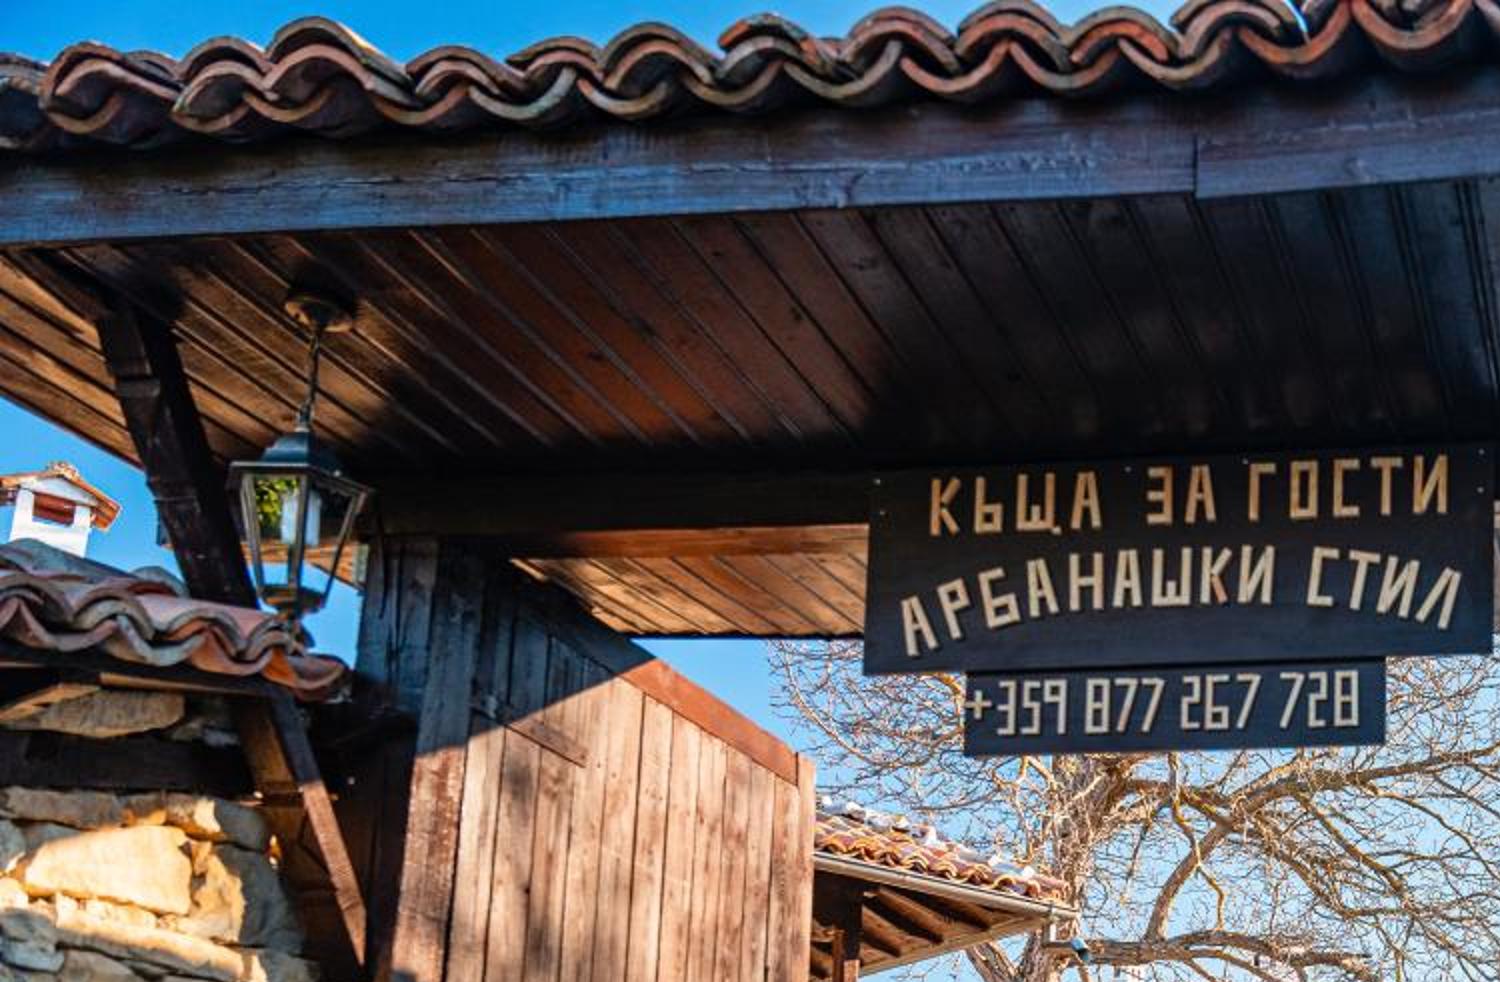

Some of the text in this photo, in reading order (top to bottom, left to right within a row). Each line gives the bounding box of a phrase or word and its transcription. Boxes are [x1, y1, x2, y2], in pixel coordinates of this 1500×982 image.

[1147, 465, 1216, 524] ЗА
[1248, 456, 1448, 521] ГОСТИ
[900, 545, 1462, 657] АРБАНАШКИ СТИЛ
[965, 671, 1358, 736] +359 877 267 728
